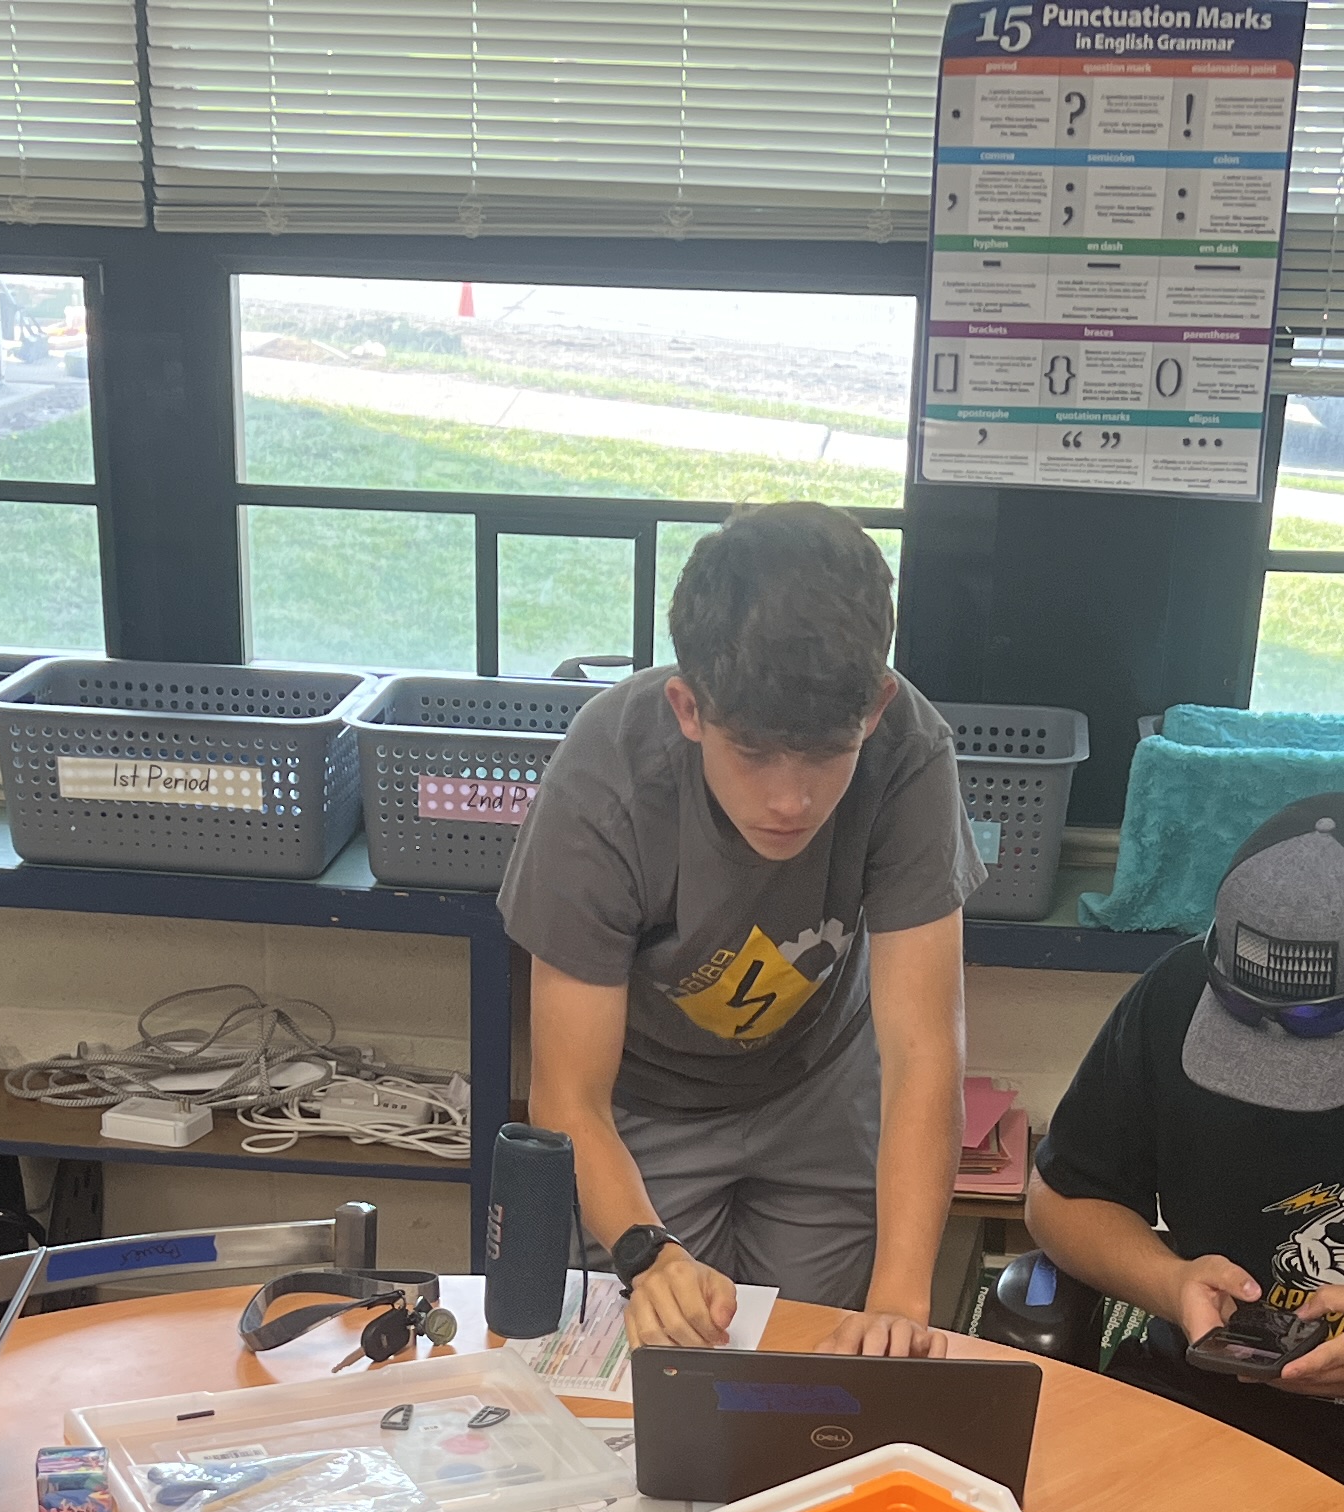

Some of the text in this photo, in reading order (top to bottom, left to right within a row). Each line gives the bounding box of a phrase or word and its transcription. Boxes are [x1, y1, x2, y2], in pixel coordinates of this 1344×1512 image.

[1042, 4, 1273, 31] Punctuation Marks
[975, 4, 1033, 53] 15
[1075, 33, 1236, 54] in English Grammar
[984, 61, 1018, 76] period
[1082, 63, 1152, 76] question mark
[1250, 64, 1277, 77] point
[979, 151, 1016, 162] comma
[1086, 153, 1136, 164] semicolon
[1212, 155, 1241, 165] colon
[972, 238, 1009, 251] hyphen
[1099, 240, 1124, 252] dash
[1217, 243, 1239, 254] dash
[968, 323, 1009, 336] brackets
[1083, 326, 1115, 338] braces
[1182, 329, 1241, 342] parentheses
[957, 408, 1010, 422] apostrophe
[1056, 410, 1131, 423] quotation marks
[1188, 413, 1220, 426] ellipsis
[112, 760, 211, 793] 1st Period
[467, 783, 505, 809] 2nd
